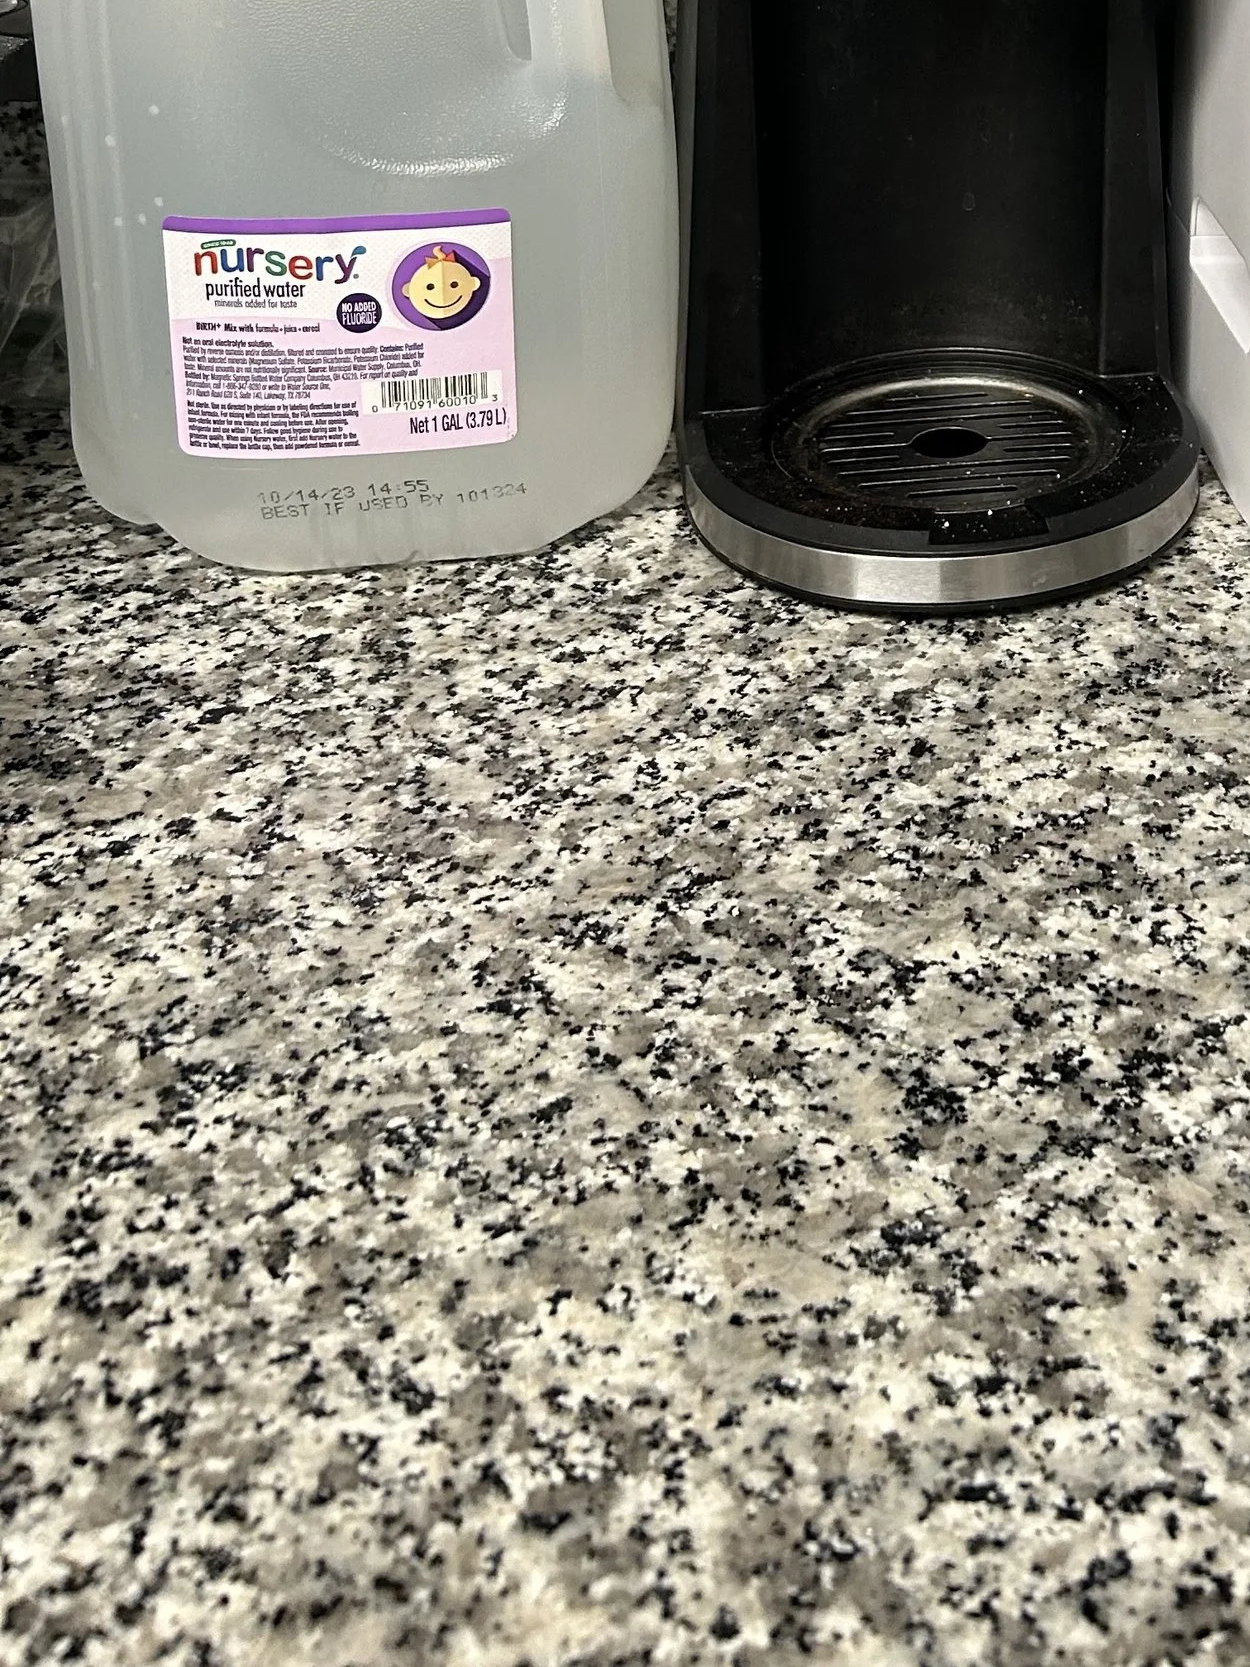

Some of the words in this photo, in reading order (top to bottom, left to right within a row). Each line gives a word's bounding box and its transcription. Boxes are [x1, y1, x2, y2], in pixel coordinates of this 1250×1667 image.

[194, 247, 360, 284] nursery
[206, 277, 262, 300] purified
[264, 283, 306, 298] water
[214, 299, 242, 308] minerals
[244, 300, 266, 308] added
[268, 300, 278, 308] for
[280, 300, 298, 308] taste
[342, 302, 352, 312] NO
[354, 302, 376, 312] ADDED
[224, 323, 237, 332] Mix
[342, 312, 376, 326] FLUORIDE
[395, 400, 432, 412] 71091
[438, 396, 477, 408] 60010
[492, 394, 498, 402] 3
[410, 417, 429, 434] Net
[432, 416, 438, 432] 1
[442, 414, 463, 431] GAL
[368, 479, 430, 496] 14:55
[261, 503, 310, 520] BEST
[325, 502, 344, 516] IF
[359, 495, 408, 512] USED
[420, 494, 444, 508] BY
